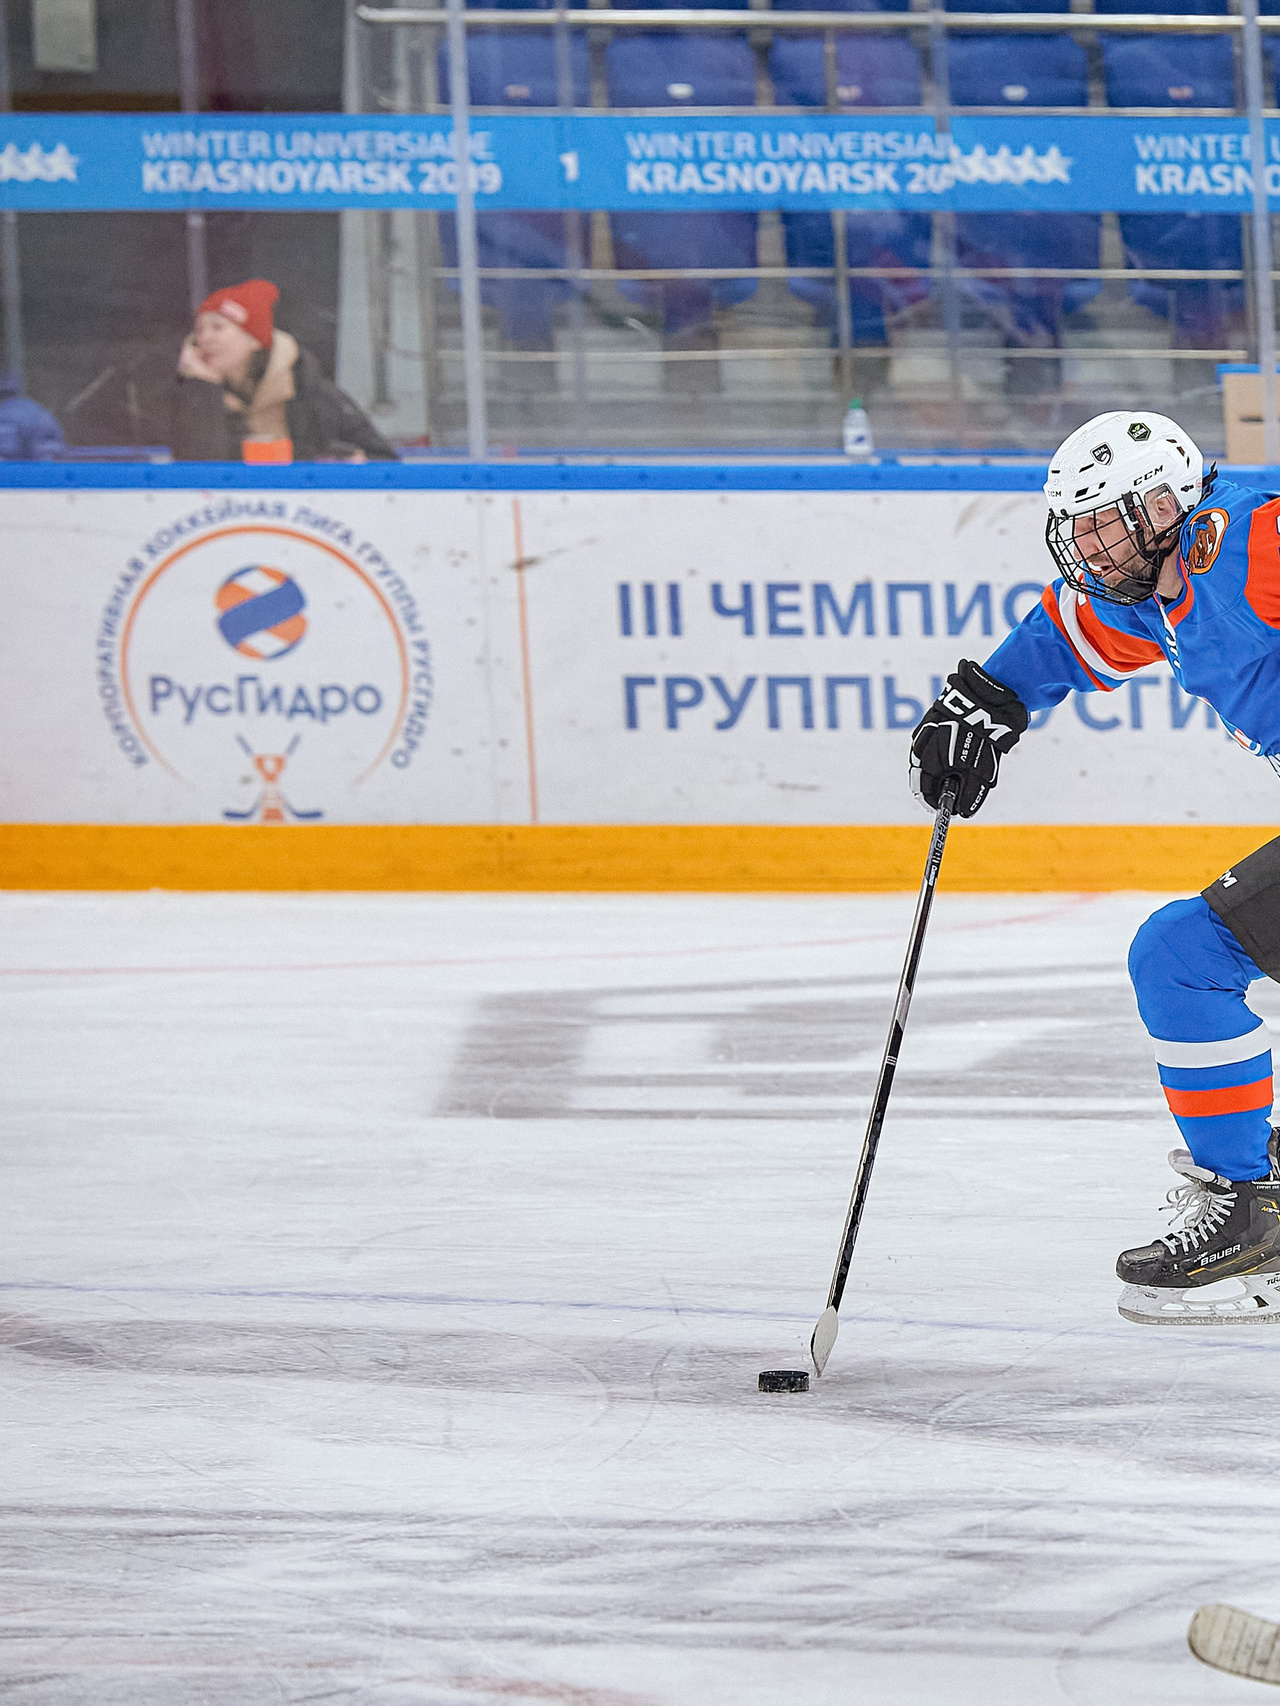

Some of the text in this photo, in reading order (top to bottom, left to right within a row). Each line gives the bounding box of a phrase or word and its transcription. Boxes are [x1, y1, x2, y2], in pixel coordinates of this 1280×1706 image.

[142, 131, 494, 160] WINTER UNIVERSIAE
[625, 132, 756, 158] WINTER
[142, 161, 414, 195] KRASNOYARSK
[626, 161, 900, 195] KRASNOYARSK
[1133, 465, 1164, 487] CCM
[96, 501, 435, 770] КОРПОРАТИВНАЯ ХОККЕЙНАЯ ЛИГА ГРУППЫ РУСГИДРО
[149, 674, 384, 726] РусГидро
[969, 784, 986, 811] CCM
[1200, 1244, 1241, 1267] BAUER
